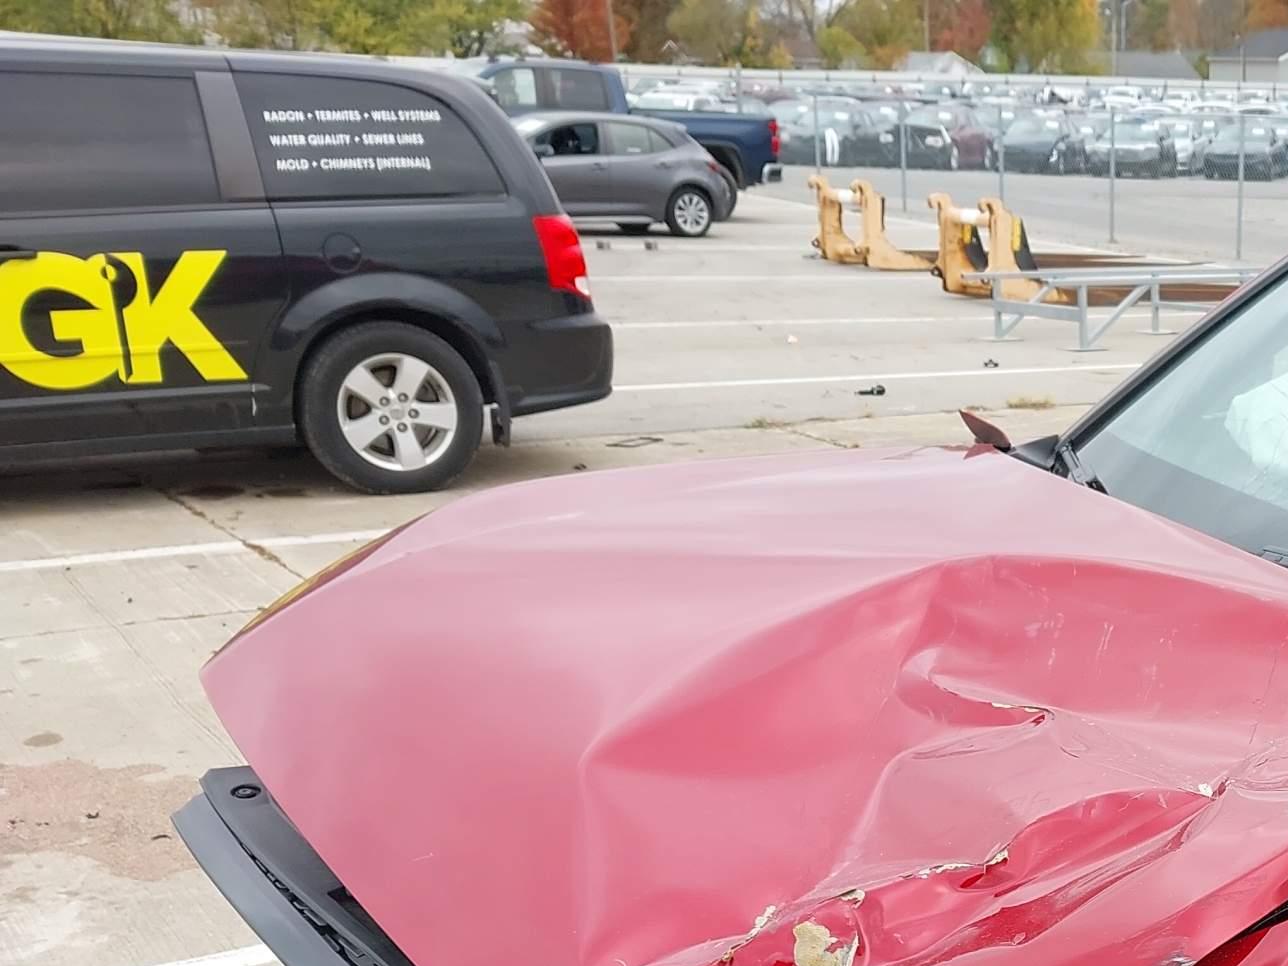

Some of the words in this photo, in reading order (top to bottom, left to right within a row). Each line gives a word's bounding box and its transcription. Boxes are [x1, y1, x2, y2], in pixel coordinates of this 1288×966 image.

[263, 110, 305, 122] RADON
[315, 110, 362, 121] TERMITES
[370, 110, 397, 121] WELL
[398, 110, 441, 121] SYSTEMS
[269, 134, 306, 146] WATER
[307, 133, 351, 146] QUALITY
[362, 133, 396, 145] SEWER
[396, 133, 425, 145] LINES
[276, 159, 309, 171] MOLD
[319, 158, 375, 170] CHIMNEYS
